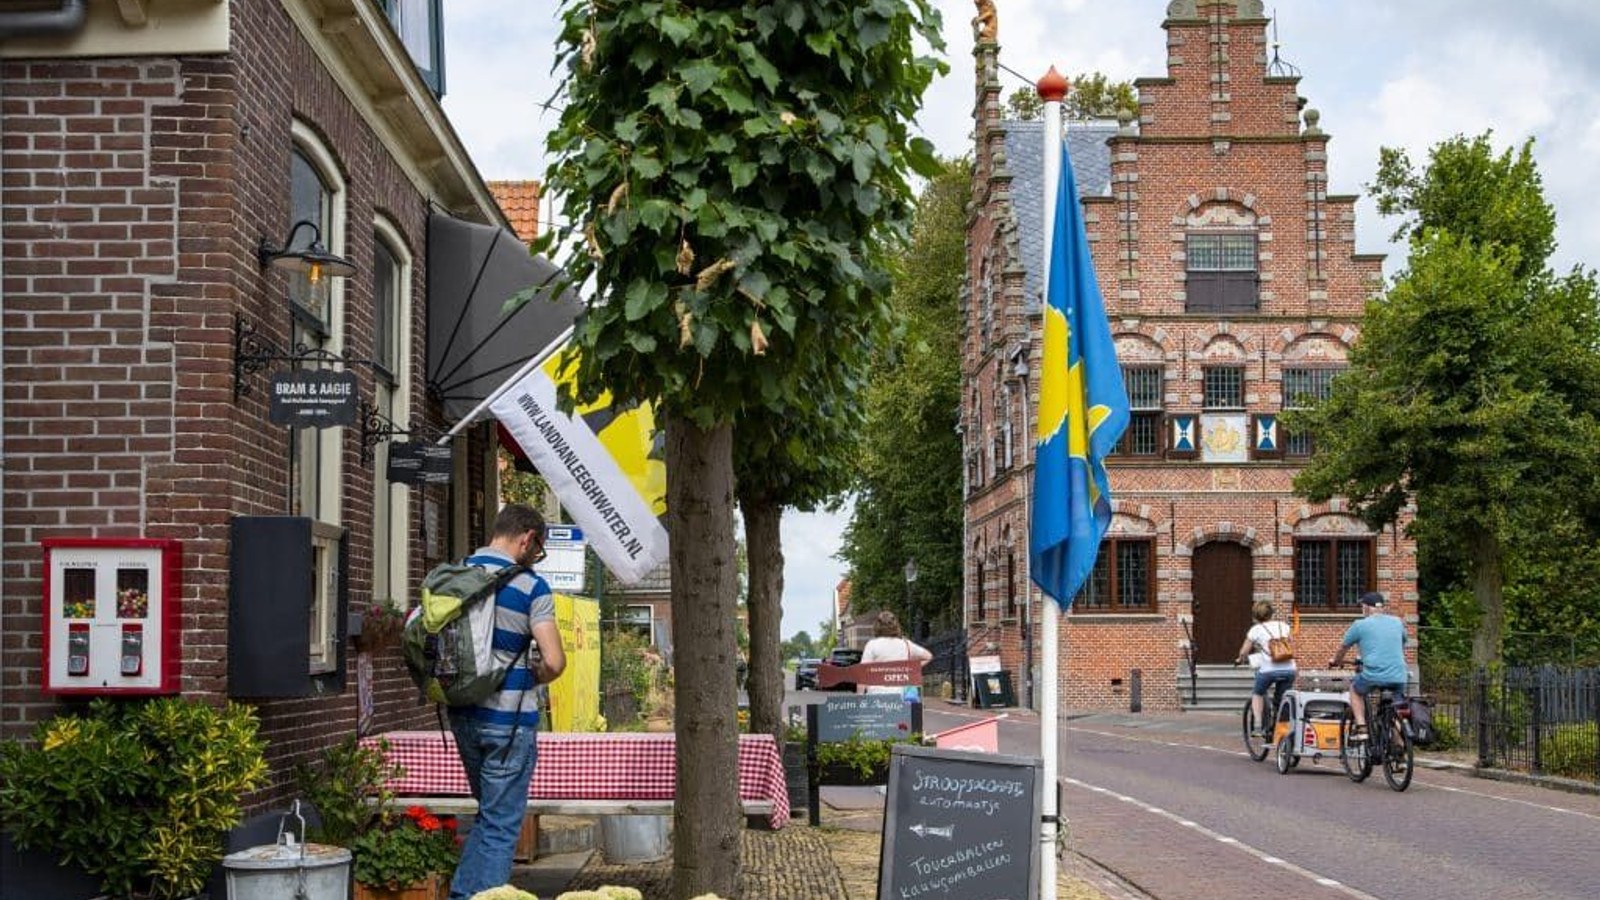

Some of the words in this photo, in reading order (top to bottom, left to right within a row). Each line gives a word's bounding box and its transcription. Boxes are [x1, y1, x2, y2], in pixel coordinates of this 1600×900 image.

[276, 382, 306, 395] BRAM
[309, 383, 317, 395] &
[320, 382, 351, 395] AAGIE
[516, 392, 645, 561] WWW.LANDVANLEEGHWATER.NL
[884, 673, 910, 682] OPEN
